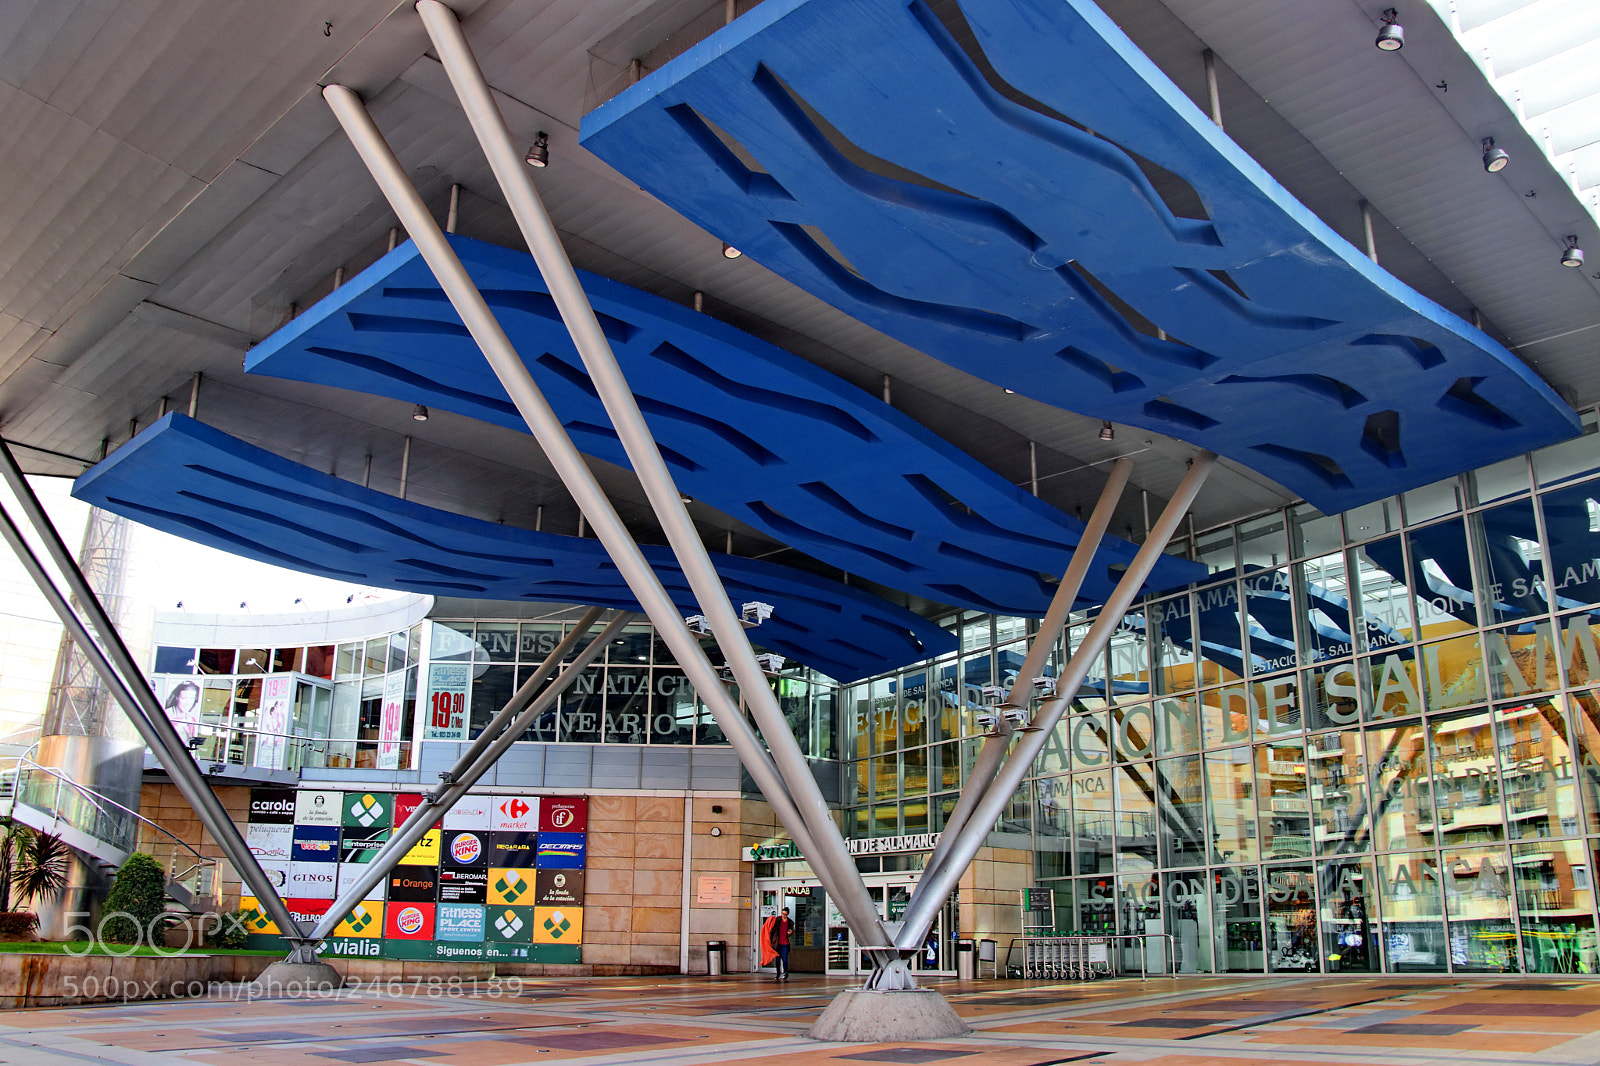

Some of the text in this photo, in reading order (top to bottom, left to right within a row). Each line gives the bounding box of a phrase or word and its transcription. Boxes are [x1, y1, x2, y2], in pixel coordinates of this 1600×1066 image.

[1152, 571, 1288, 624] SALAMANCA
[1219, 675, 1302, 743] DE
[252, 799, 295, 811] carola
[500, 821, 528, 829] market
[454, 838, 478, 850] BURGER
[862, 839, 878, 852] DE
[454, 844, 478, 857] KING
[293, 873, 333, 882] GINOS
[1270, 857, 1501, 903] SALAMANCA
[402, 878, 434, 890] Orange
[401, 912, 420, 922] BURGER
[440, 907, 483, 919] Fitness
[401, 917, 421, 928] KING
[440, 918, 482, 928] PLACE
[333, 938, 380, 956] vialia
